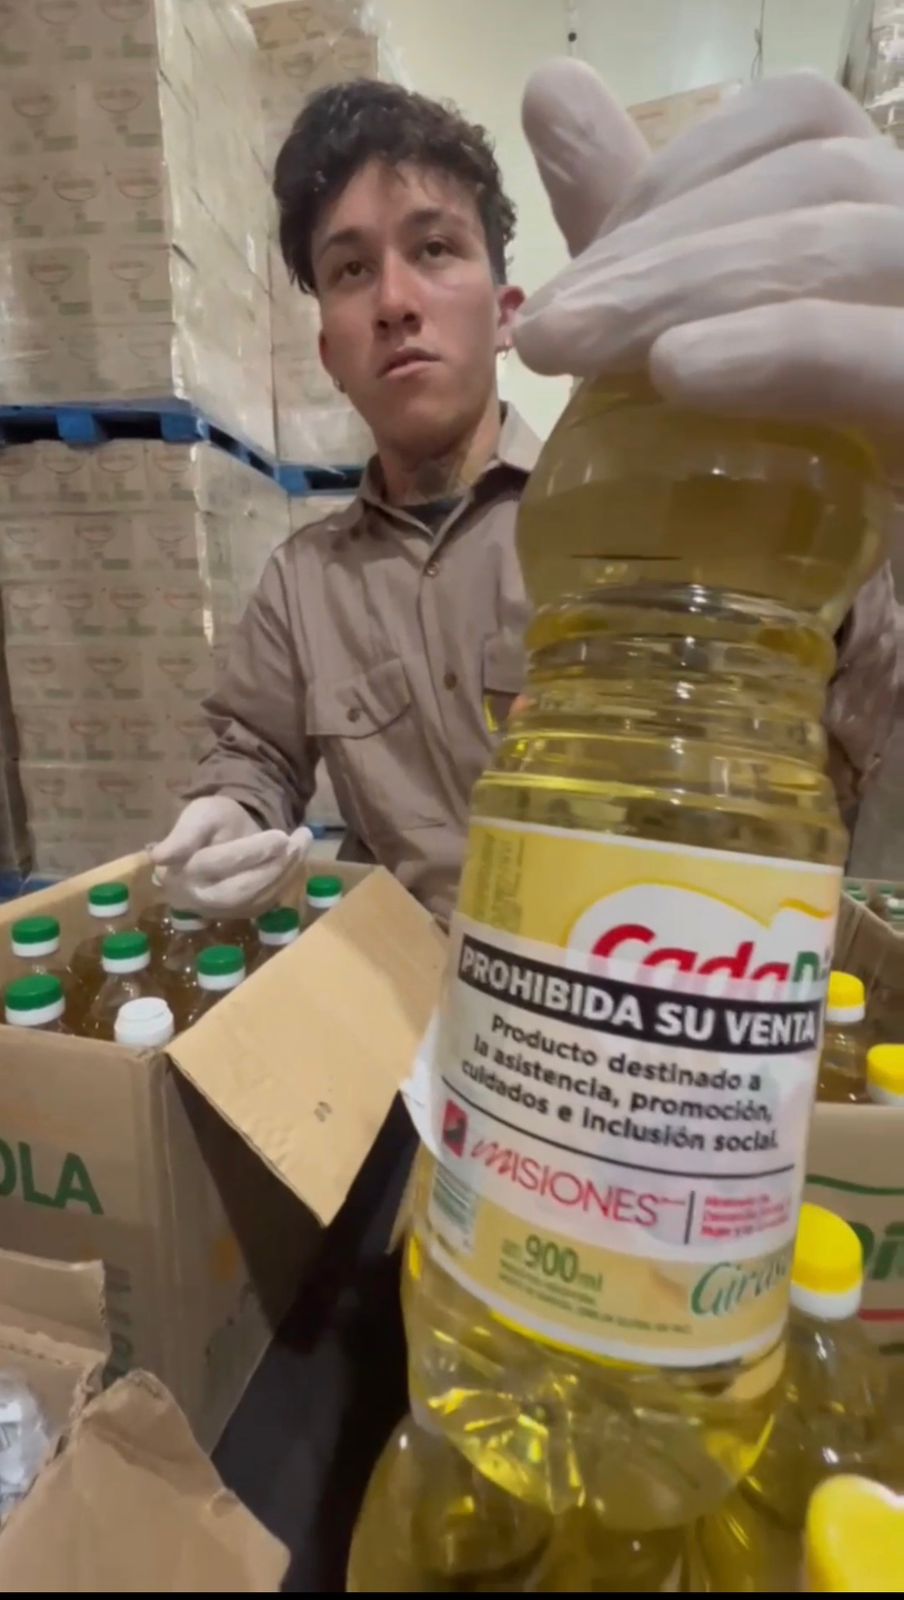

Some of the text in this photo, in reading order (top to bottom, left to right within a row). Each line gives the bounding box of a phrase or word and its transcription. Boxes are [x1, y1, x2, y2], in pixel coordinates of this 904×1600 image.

[461, 945, 816, 1047] PROHIBIDA SU VENTA
[473, 1033, 772, 1123] la asistencia, promoción,
[491, 1014, 761, 1092] Producto destinado a
[461, 1059, 779, 1152] cuidados e inclusión social.
